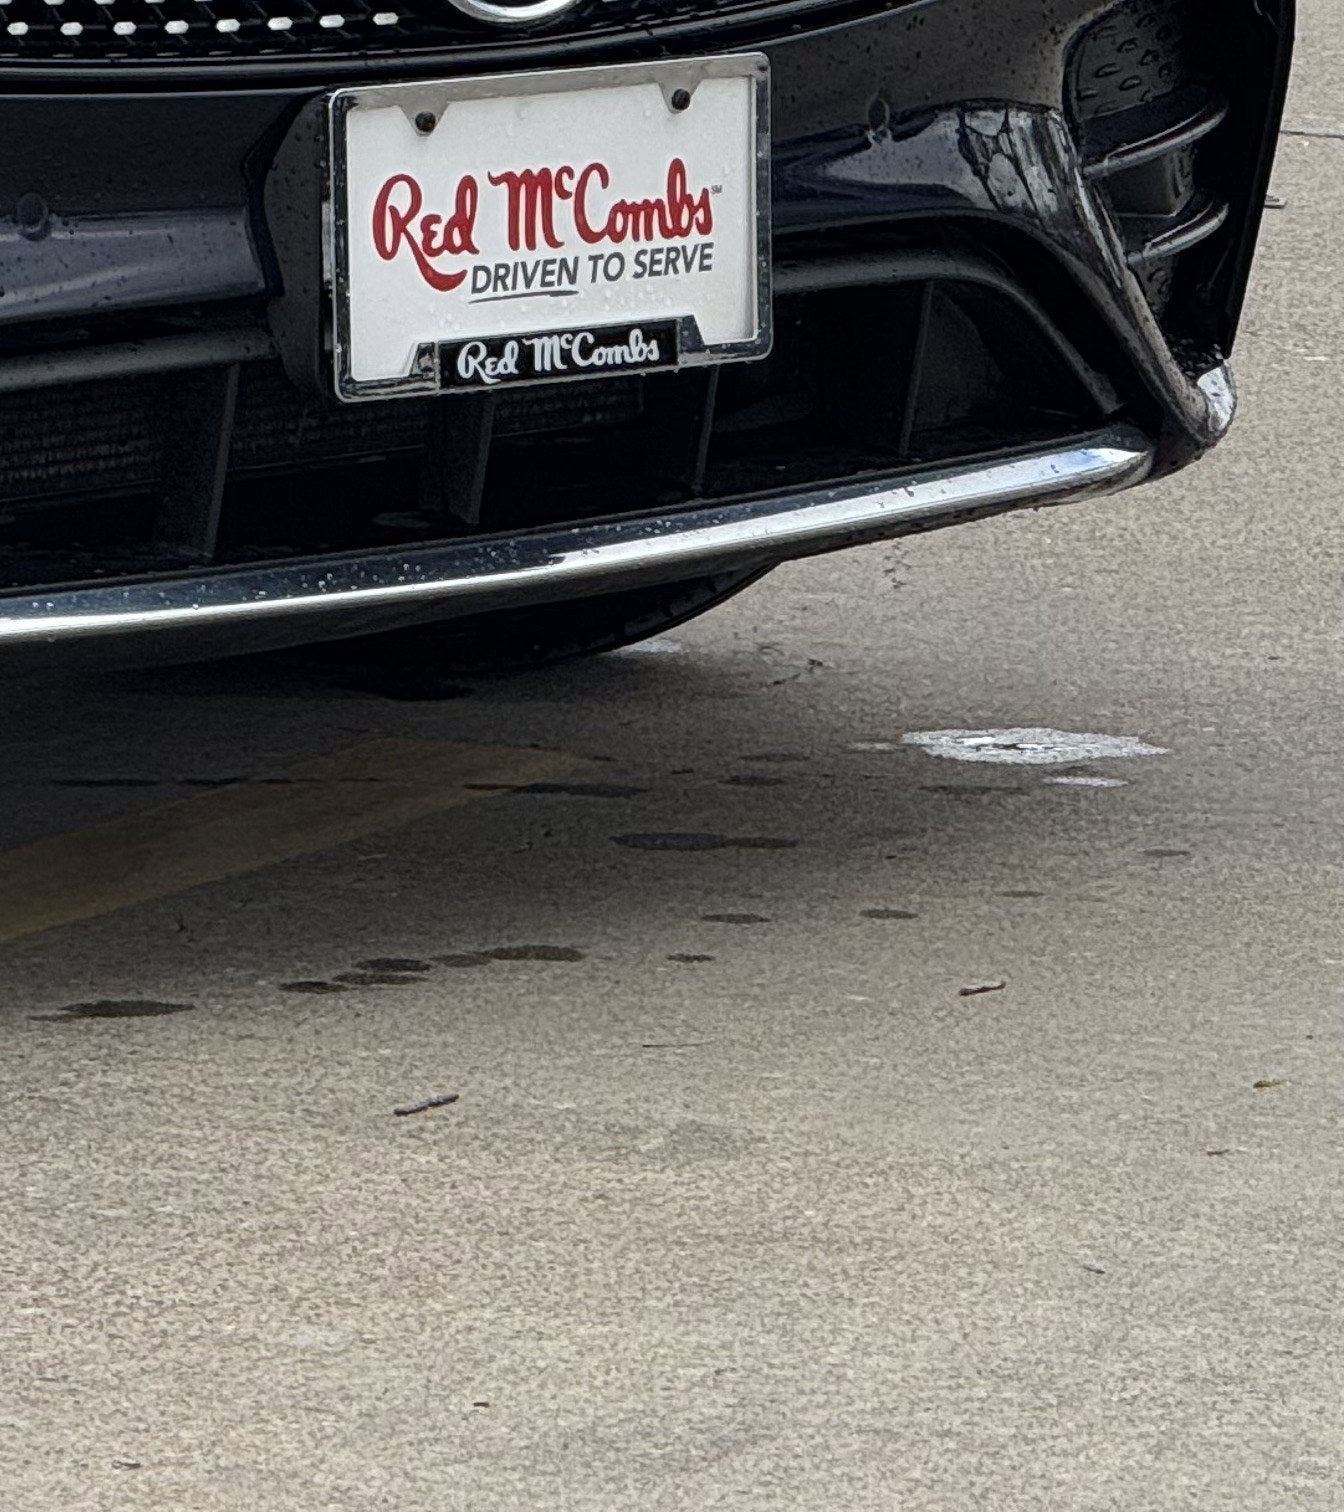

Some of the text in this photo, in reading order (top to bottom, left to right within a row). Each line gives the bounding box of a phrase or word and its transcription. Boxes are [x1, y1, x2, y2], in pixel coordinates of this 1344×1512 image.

[373, 173, 480, 292] Red
[487, 157, 714, 252] McCombs
[470, 242, 715, 294] DRIVEN TO SERVE
[456, 328, 660, 384] Red McCombs
